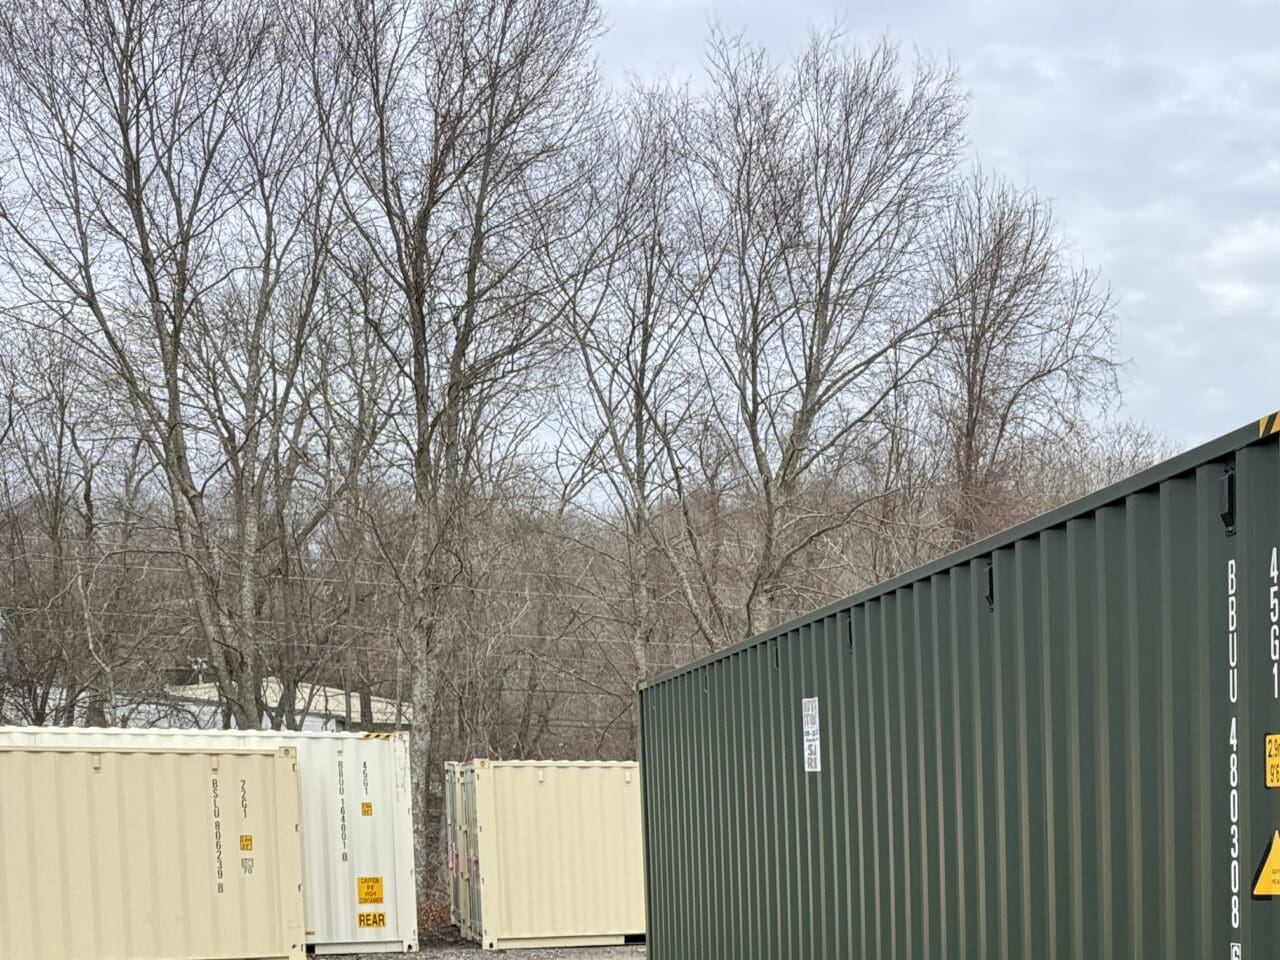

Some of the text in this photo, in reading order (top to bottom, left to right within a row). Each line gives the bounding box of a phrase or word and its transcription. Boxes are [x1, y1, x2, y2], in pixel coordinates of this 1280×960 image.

[1228, 559, 1238, 703] BBUU
[1270, 547, 1280, 699] 45G1
[1230, 717, 1239, 928] 480308
[359, 914, 385, 926] REAR
